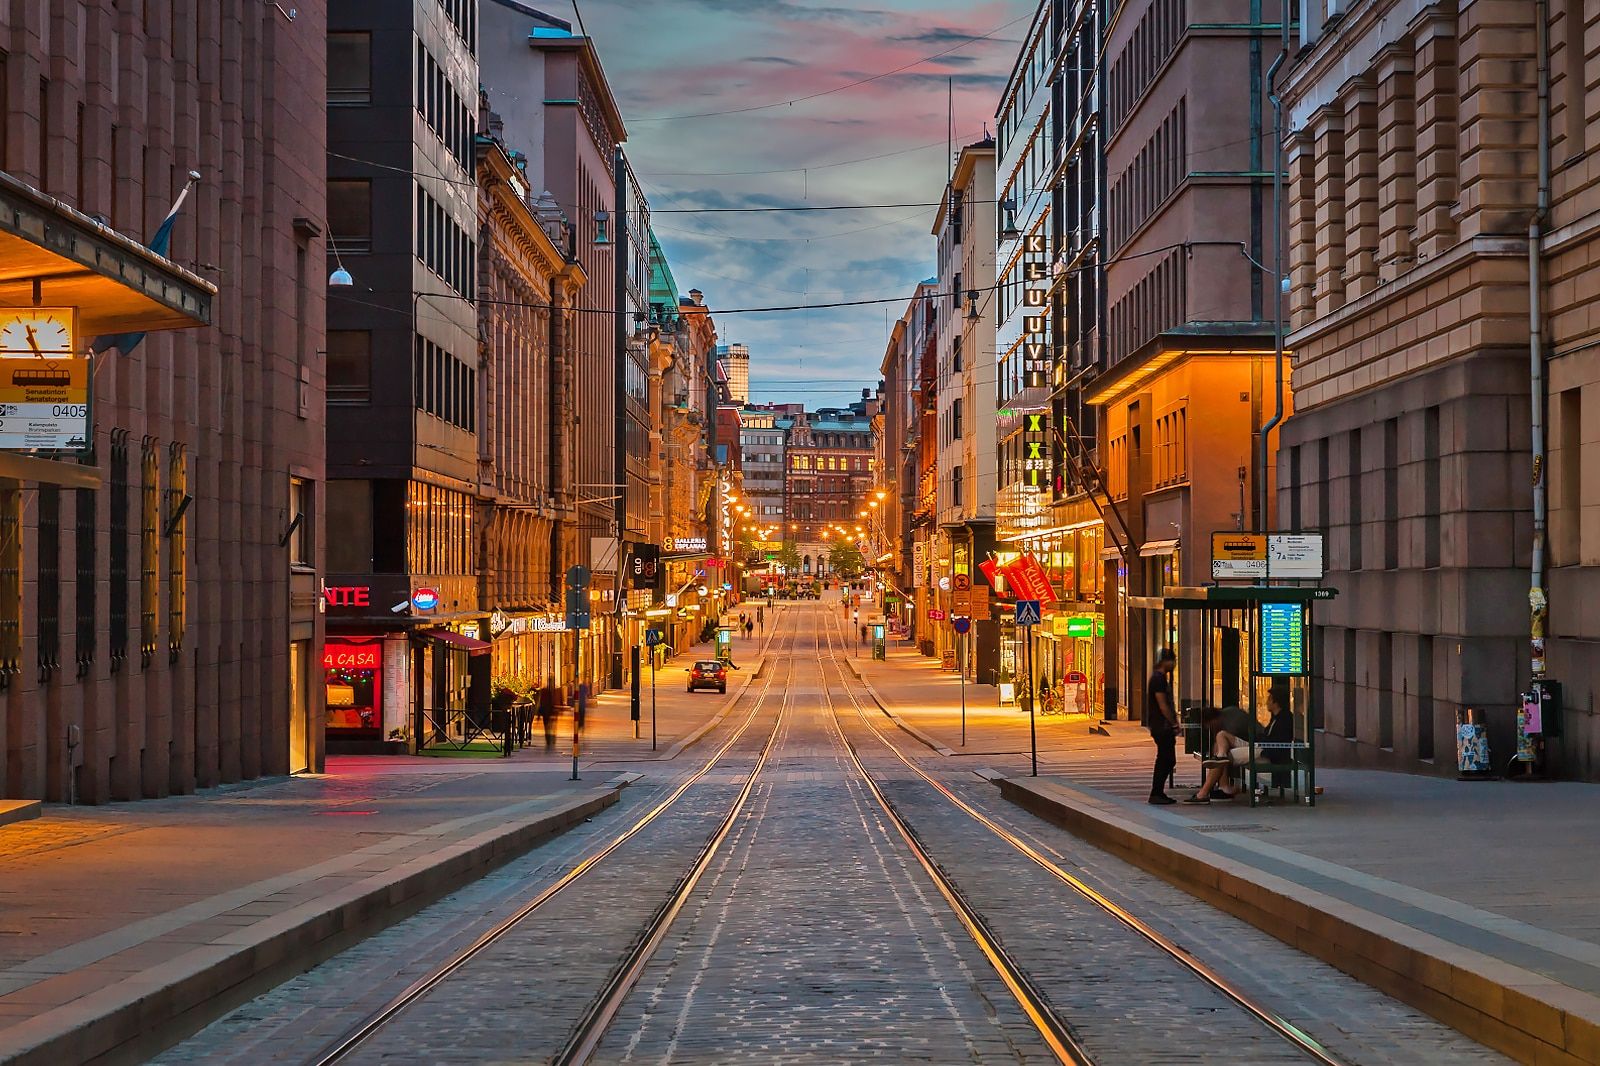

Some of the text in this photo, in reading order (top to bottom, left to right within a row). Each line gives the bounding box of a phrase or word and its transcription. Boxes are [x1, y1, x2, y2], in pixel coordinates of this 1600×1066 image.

[1028, 236, 1041, 387] KLUUVI
[53, 405, 87, 417] 0405
[1270, 544, 1276, 552] 5
[634, 557, 642, 575] GLO
[1246, 560, 1266, 569] 0406
[1213, 569, 1220, 577] 2
[1024, 565, 1051, 606] KLUUVI
[337, 653, 374, 665] CASA
